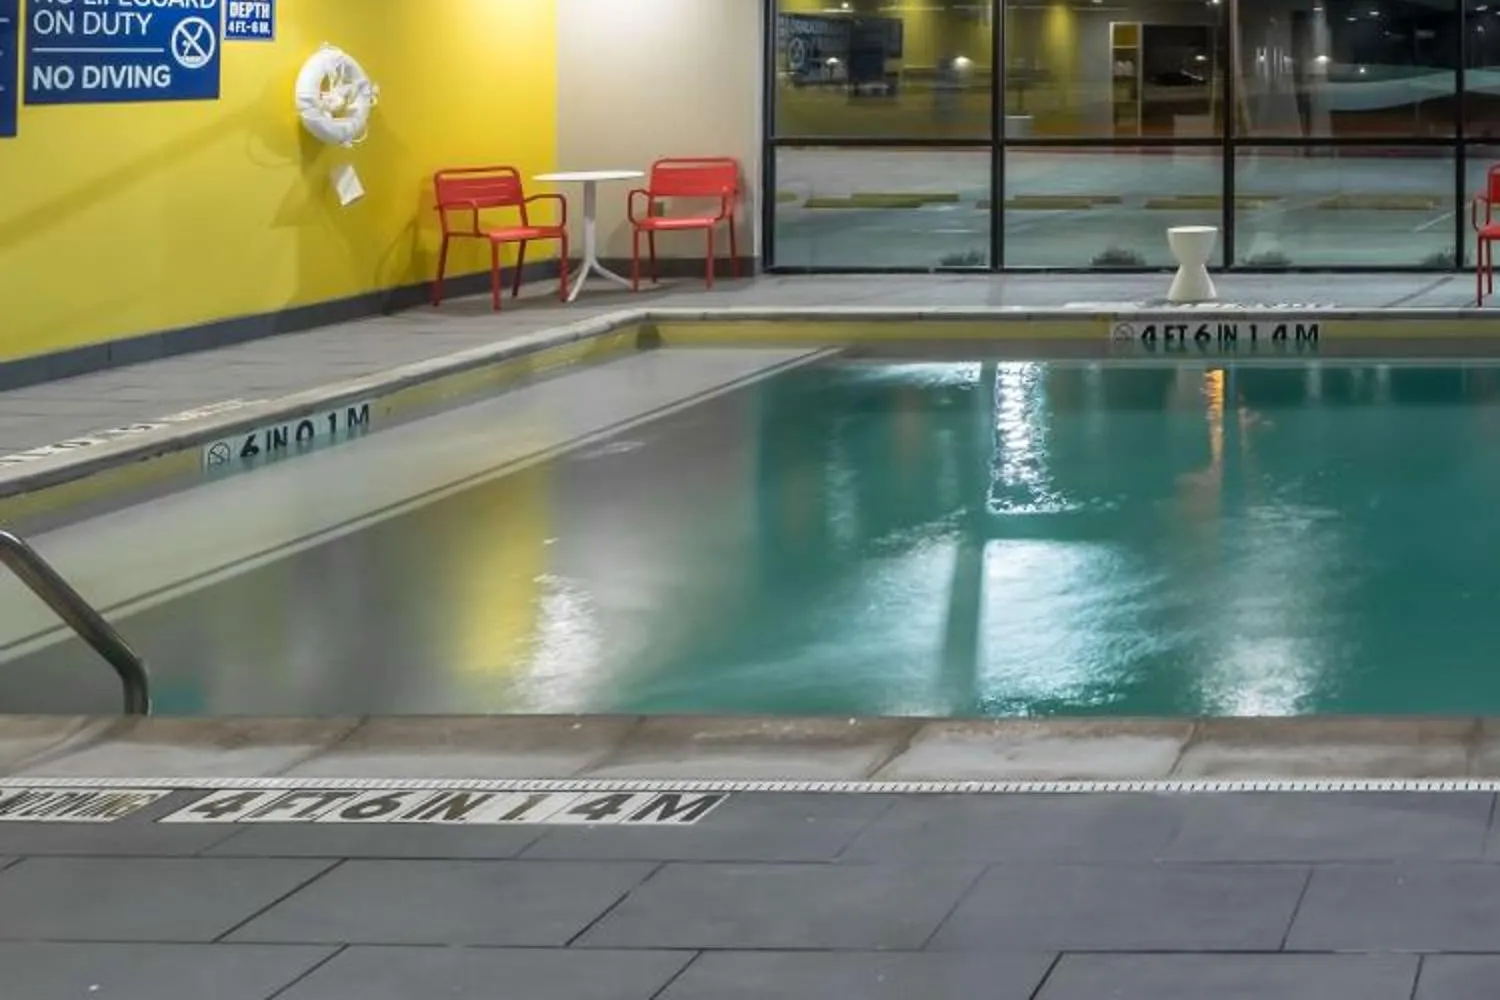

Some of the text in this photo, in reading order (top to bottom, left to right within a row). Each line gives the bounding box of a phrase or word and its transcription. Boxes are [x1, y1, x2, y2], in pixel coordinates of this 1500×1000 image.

[33, 9, 152, 36] ON DUTY
[229, 1, 270, 19] DEPTH
[32, 65, 171, 91] NO DIVING
[1141, 324, 1157, 341] 4
[1164, 324, 1188, 341] FT
[1194, 324, 1211, 341] 6
[1217, 324, 1238, 341] IN
[1272, 324, 1287, 341] 4
[1295, 324, 1320, 341] M
[266, 426, 288, 451] IN
[328, 412, 337, 434] 1
[347, 403, 369, 429] M
[190, 791, 264, 818] 4
[340, 791, 414, 819] 6
[568, 793, 635, 820] 4
[628, 793, 723, 821] M
